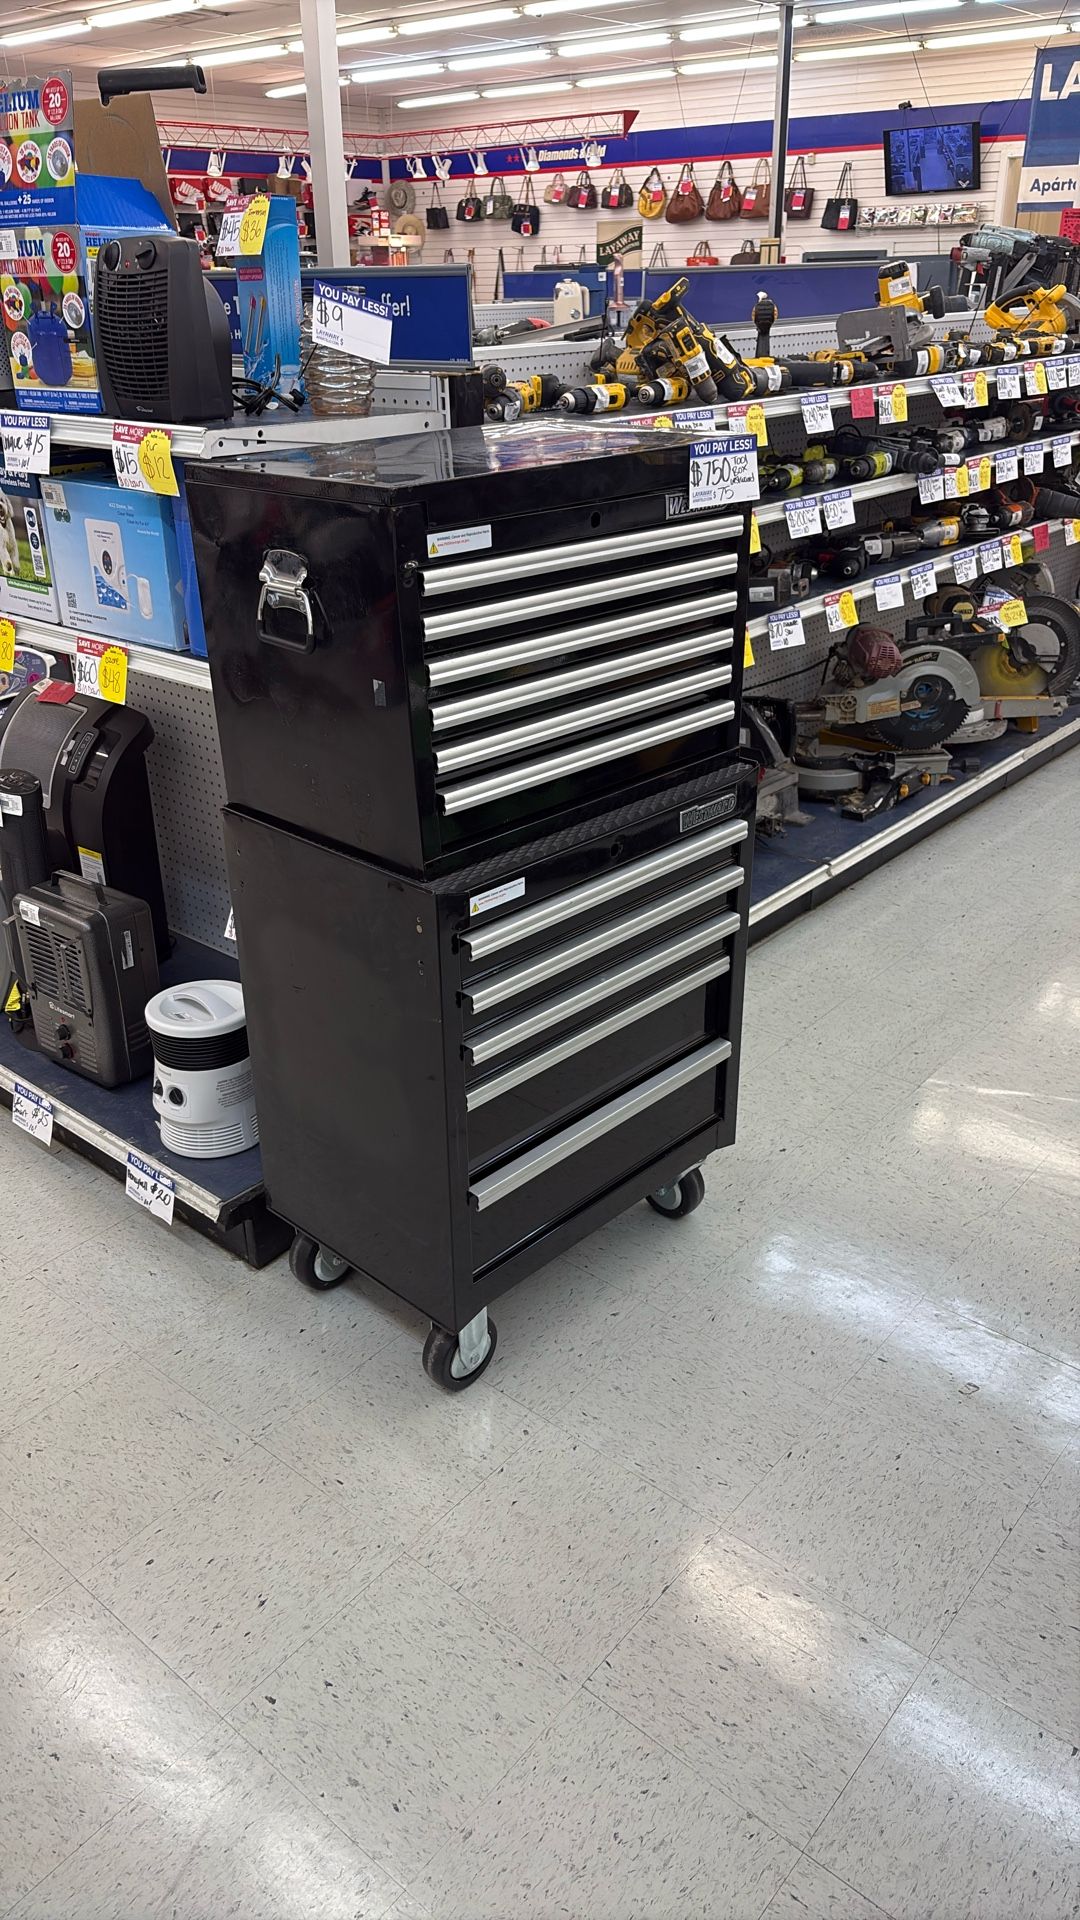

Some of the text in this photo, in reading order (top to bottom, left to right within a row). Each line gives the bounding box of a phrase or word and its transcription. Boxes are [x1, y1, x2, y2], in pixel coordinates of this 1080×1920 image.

[48, 92, 62, 108] 20
[22, 110, 40, 129] TANK
[538, 147, 578, 162] Diamonds
[226, 198, 237, 206] SAVE
[220, 217, 240, 242] $45
[241, 219, 262, 242] $36
[57, 242, 70, 258] 20
[599, 230, 640, 256] LAYAWAY
[30, 259, 48, 274] TANK
[319, 284, 390, 317] YOU PAY LESS!
[381, 293, 412, 317] ffer!
[316, 298, 344, 331] $9
[4, 416, 48, 428] YOU PAY LESS!
[696, 410, 712, 418] LESS!
[114, 425, 144, 437] SAVE MORE
[24, 432, 46, 456] $15
[694, 439, 753, 456] YOU PAY LESS!
[114, 446, 138, 474] $15
[142, 452, 170, 480] $12
[731, 454, 748, 466] Tool
[690, 456, 732, 488] $750
[692, 490, 712, 498] LAYAWAY
[718, 486, 734, 501] 75
[1004, 610, 1025, 622] $240
[78, 640, 104, 652] SAVE MORE
[78, 659, 98, 684] $60
[102, 666, 120, 694] $48
[683, 798, 734, 828] WESTWARD
[17, 1085, 38, 1102] YOU PAY
[130, 1154, 155, 1177] YOU PAY
[150, 1182, 172, 1206] $20
